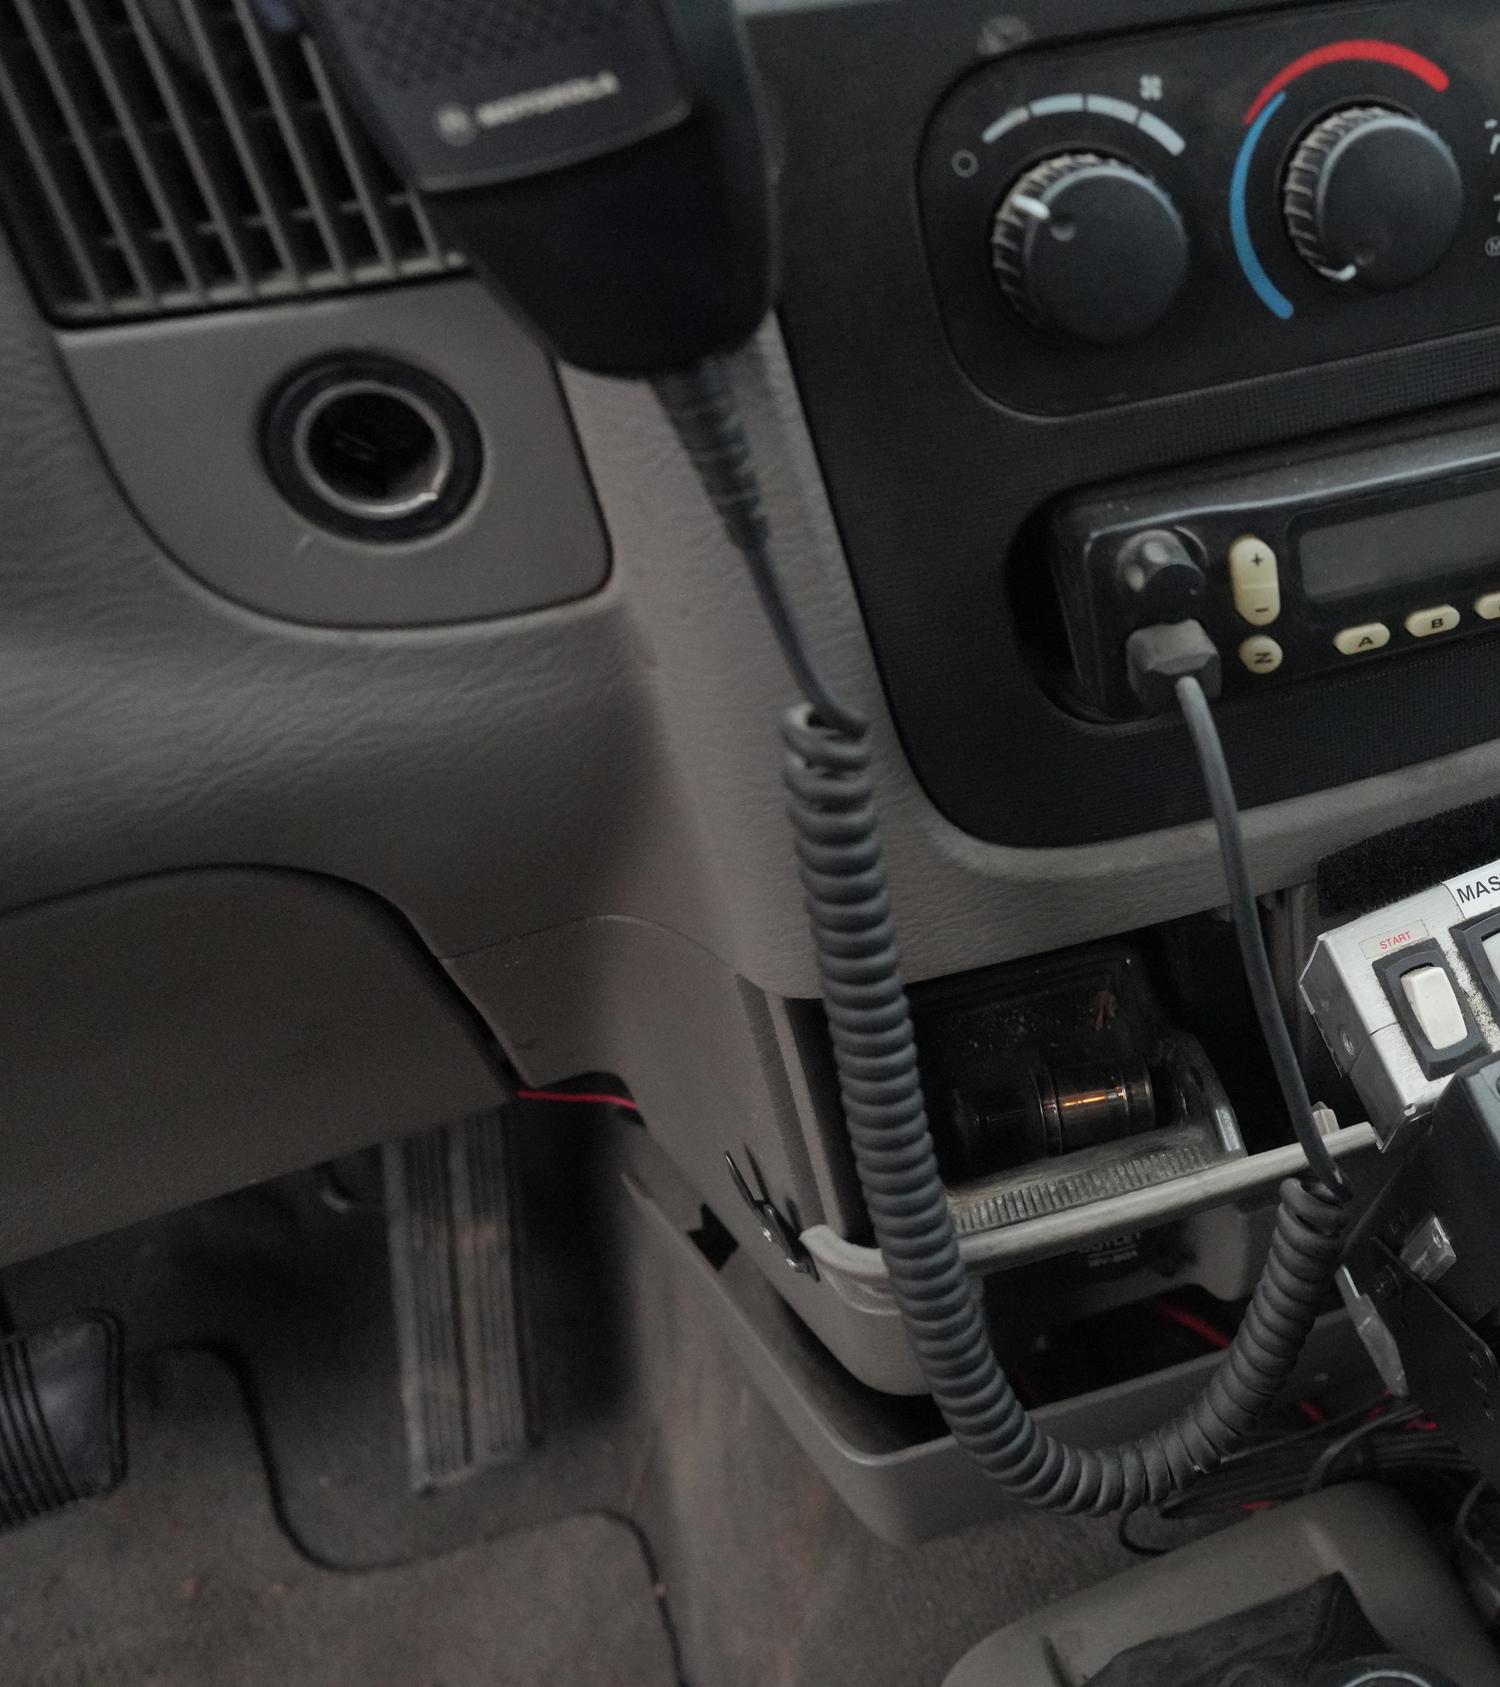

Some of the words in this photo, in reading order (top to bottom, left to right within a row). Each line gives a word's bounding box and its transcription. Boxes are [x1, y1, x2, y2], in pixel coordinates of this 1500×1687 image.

[1430, 617, 1444, 629] B
[1357, 635, 1375, 648] A
[1379, 930, 1412, 950] START
